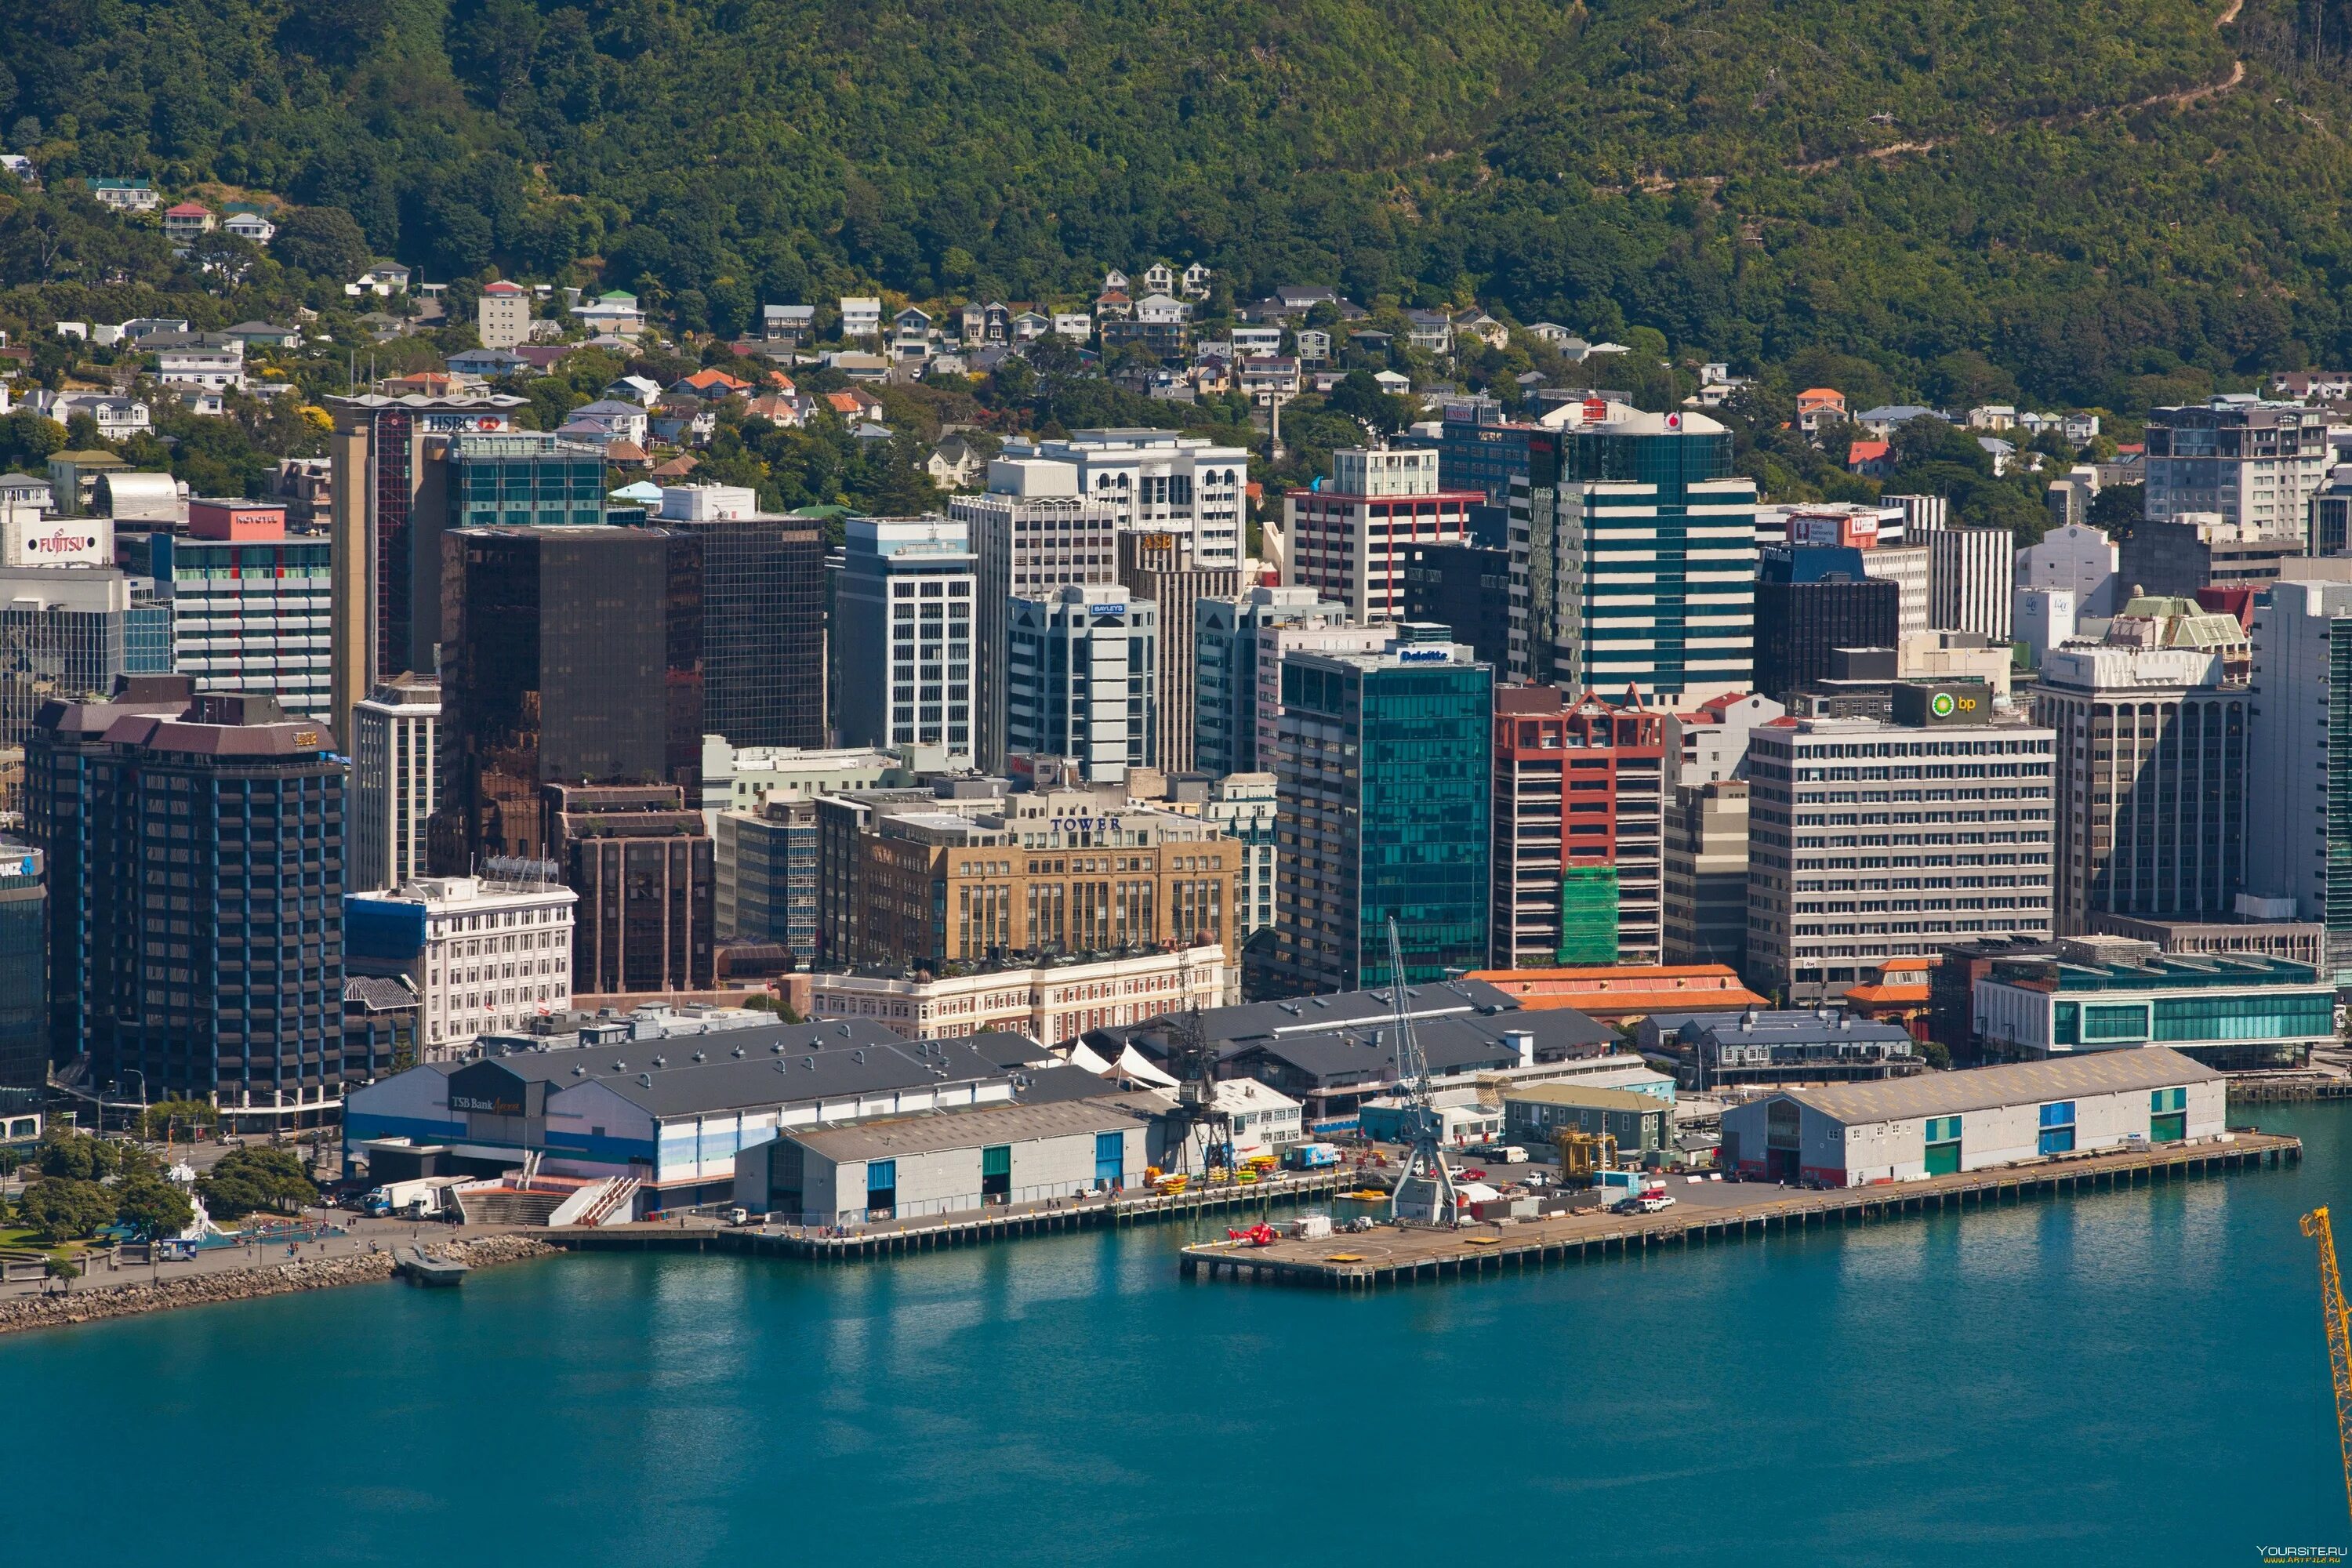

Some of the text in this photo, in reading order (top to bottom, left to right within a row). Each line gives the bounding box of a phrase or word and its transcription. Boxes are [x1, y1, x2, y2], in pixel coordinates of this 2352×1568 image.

[430, 416, 476, 430] HSBC
[236, 515, 278, 524] NOVOTEL
[39, 529, 85, 556] FUJITSU
[1142, 534, 1171, 550] ASB
[1400, 650, 1448, 661] Deloitte
[1958, 696, 1976, 712] bp
[1050, 818, 1123, 832] TOWER
[452, 1096, 470, 1108] TSB
[470, 1098, 493, 1110] Bank
